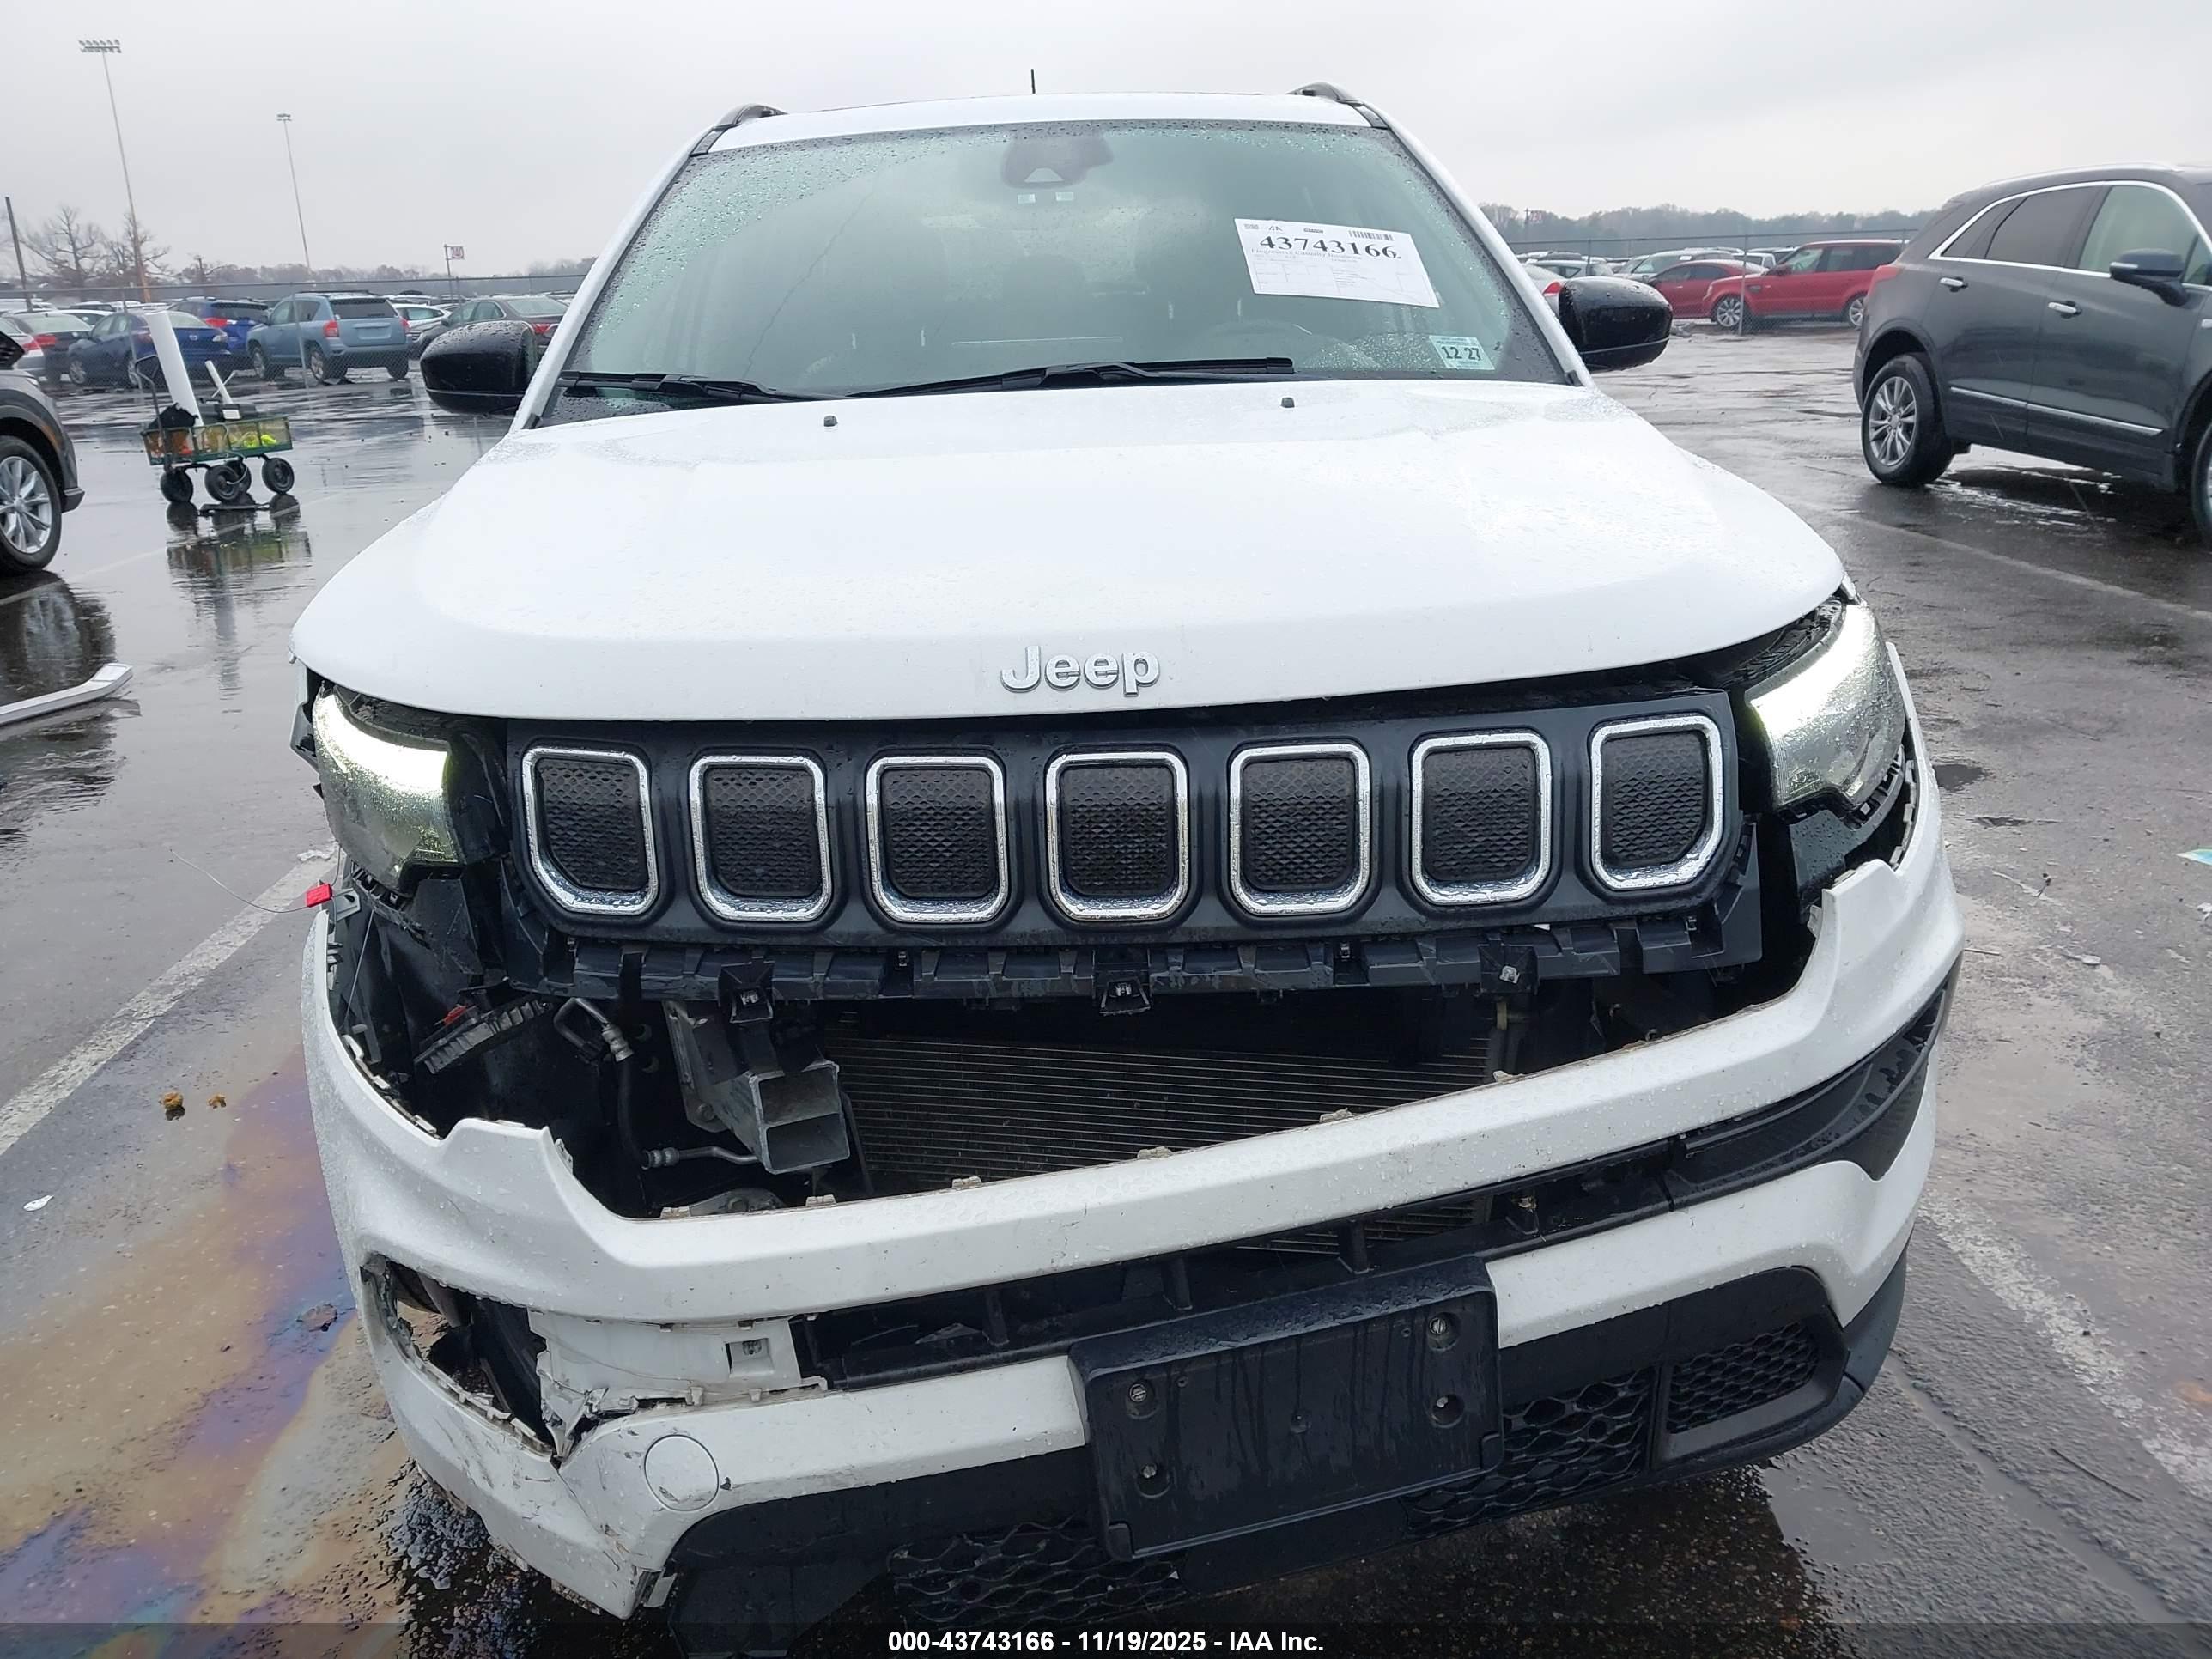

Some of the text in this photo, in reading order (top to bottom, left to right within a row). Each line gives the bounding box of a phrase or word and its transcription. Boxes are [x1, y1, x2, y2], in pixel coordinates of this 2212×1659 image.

[1441, 346, 1481, 361] 12 27
[1000, 645, 1160, 697] Jeep
